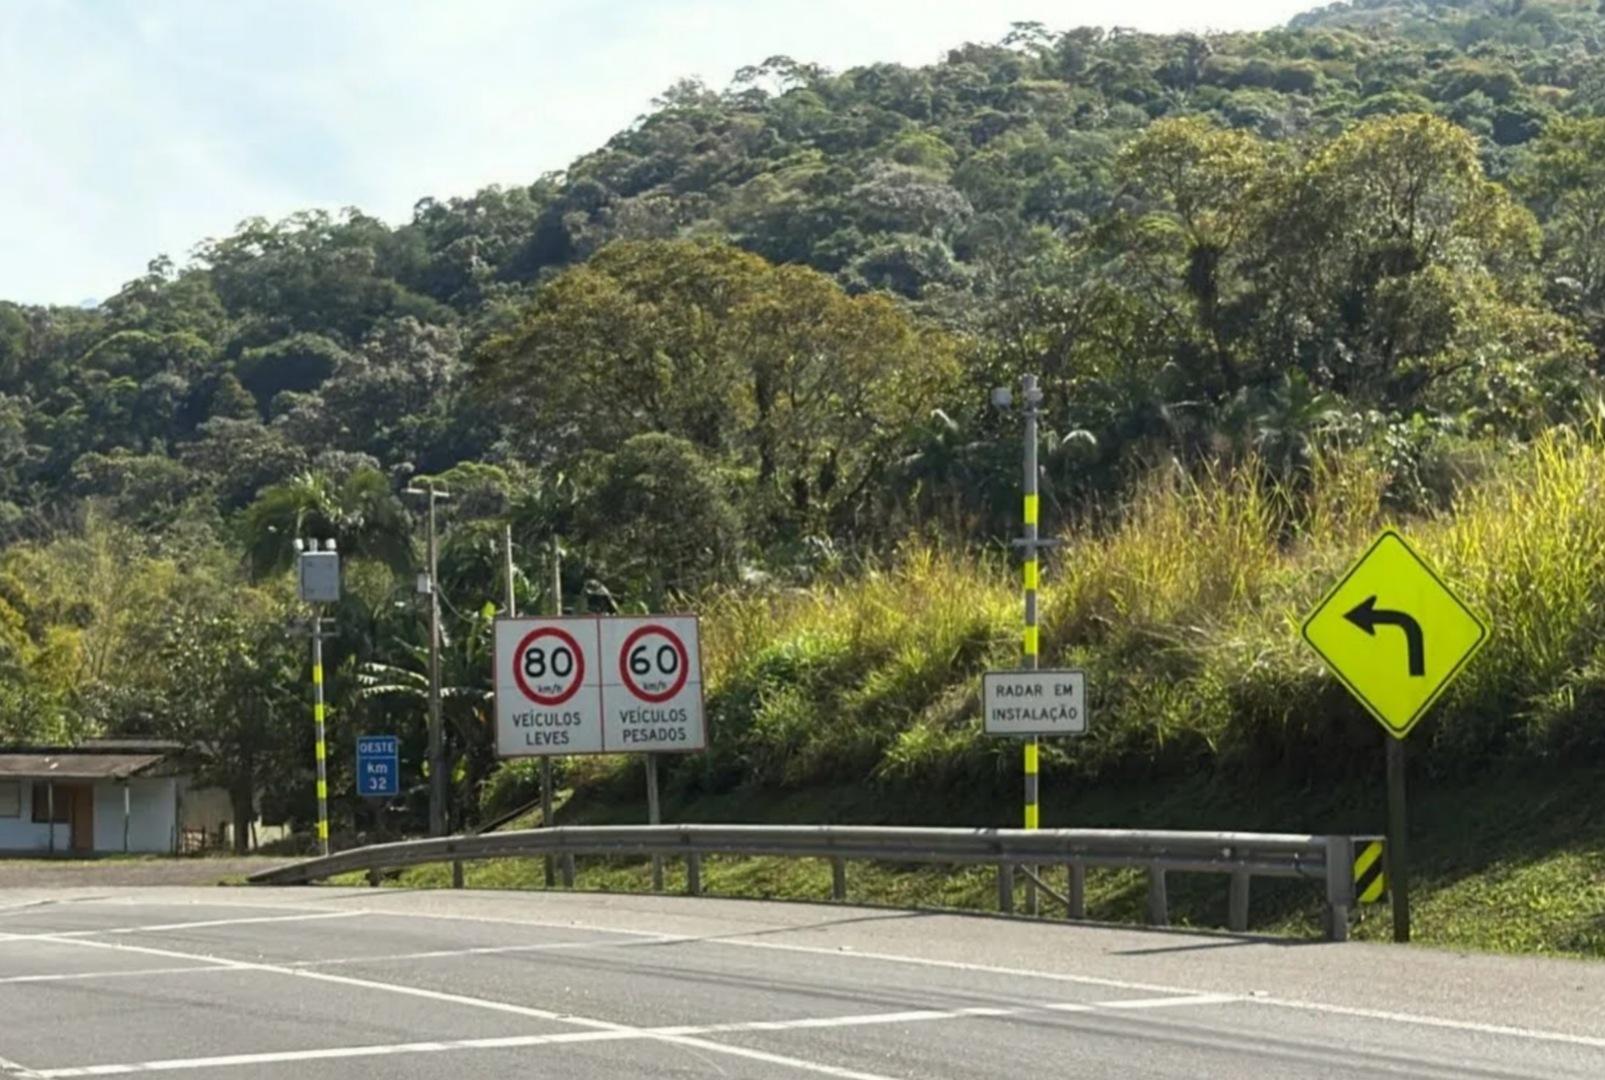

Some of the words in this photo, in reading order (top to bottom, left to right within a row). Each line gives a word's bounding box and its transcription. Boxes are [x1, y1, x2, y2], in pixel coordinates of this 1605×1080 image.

[525, 647, 573, 678] 80
[630, 645, 678, 676] 60
[538, 683, 564, 694] km/h
[643, 681, 667, 692] km/h
[995, 684, 1043, 698] RADAR
[1054, 684, 1073, 697] EM
[512, 710, 581, 728] VEÍCULOS
[620, 706, 687, 724] VEÍCULOS
[992, 704, 1078, 723] INSTALAÇÃO
[526, 731, 570, 746] LEVES
[623, 727, 687, 743] PESADOS
[360, 742, 394, 753] OESTE
[367, 762, 388, 774] km
[369, 777, 387, 790] 32
